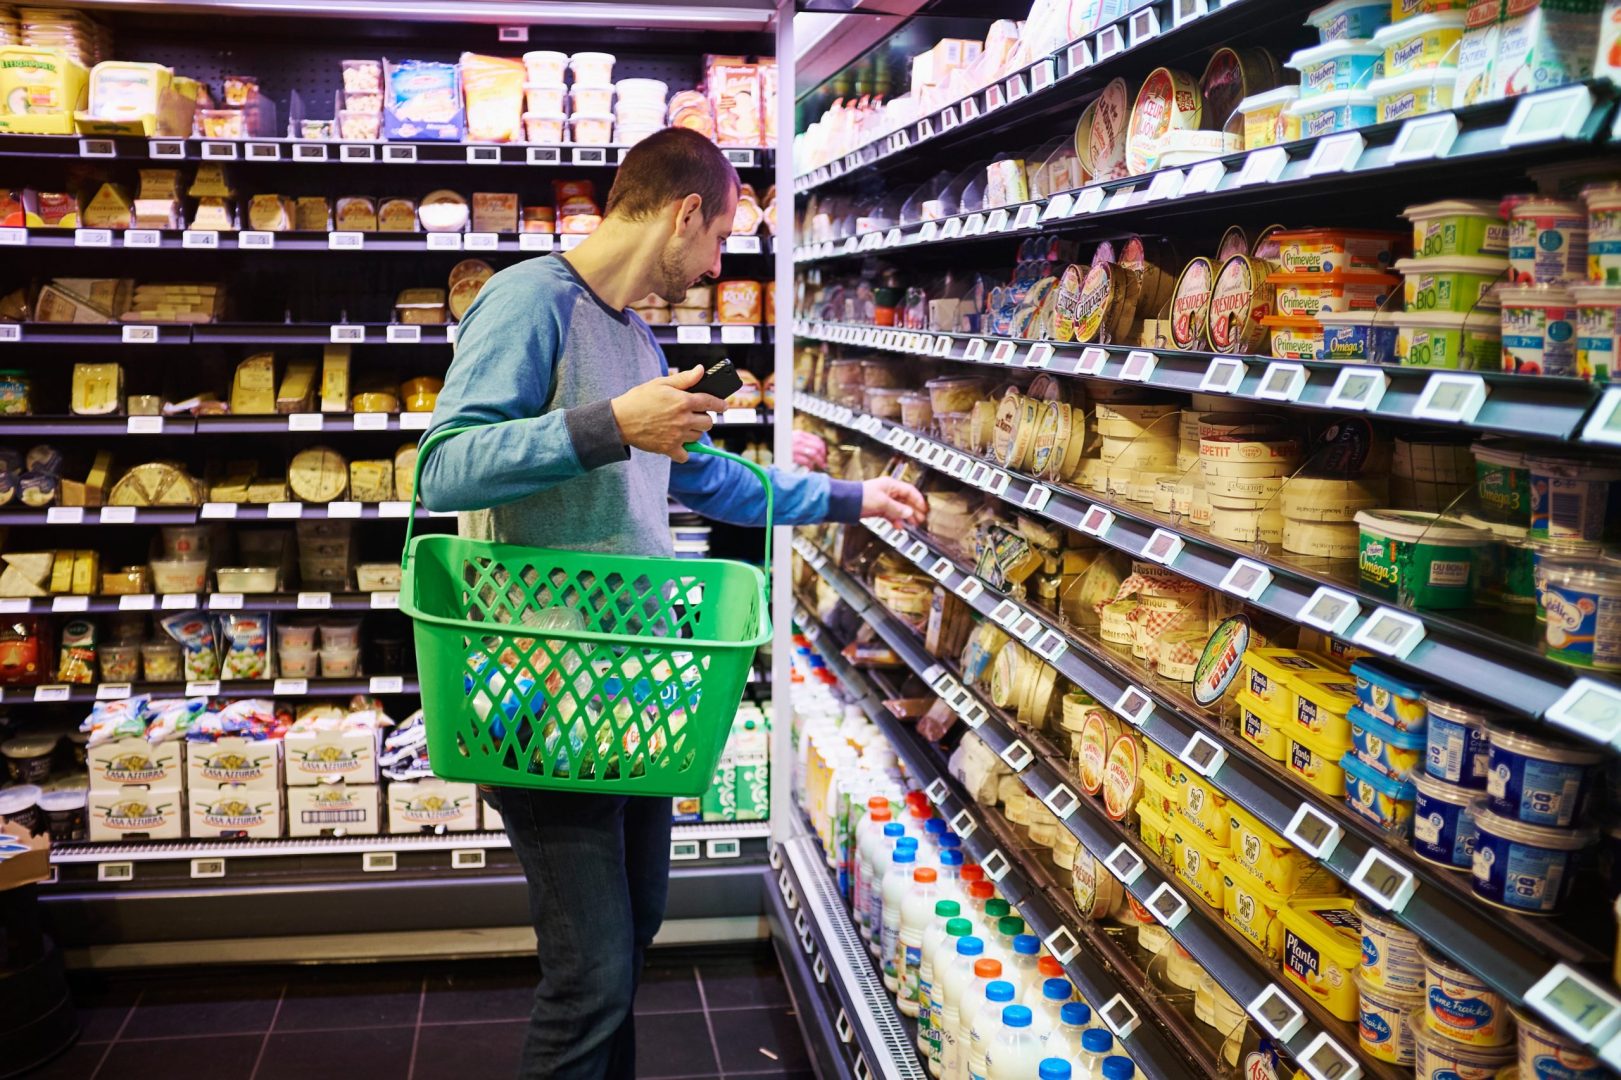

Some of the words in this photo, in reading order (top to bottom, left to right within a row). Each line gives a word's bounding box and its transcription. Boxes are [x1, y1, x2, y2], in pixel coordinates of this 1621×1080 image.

[1286, 252, 1320, 266] Primevère
[1176, 291, 1210, 313] PRÉSIDENT
[1213, 291, 1251, 316] PRÉSIDENT
[1283, 295, 1319, 309] Primevère
[1277, 338, 1313, 353] Primevère
[1357, 339, 1364, 354] 3
[1360, 550, 1389, 581] Oméga
[1389, 565, 1398, 583] 3
[204, 769, 222, 778] CASA
[205, 815, 223, 825] CASA
[1287, 933, 1317, 970] Planta
[1291, 954, 1304, 975] Fin
